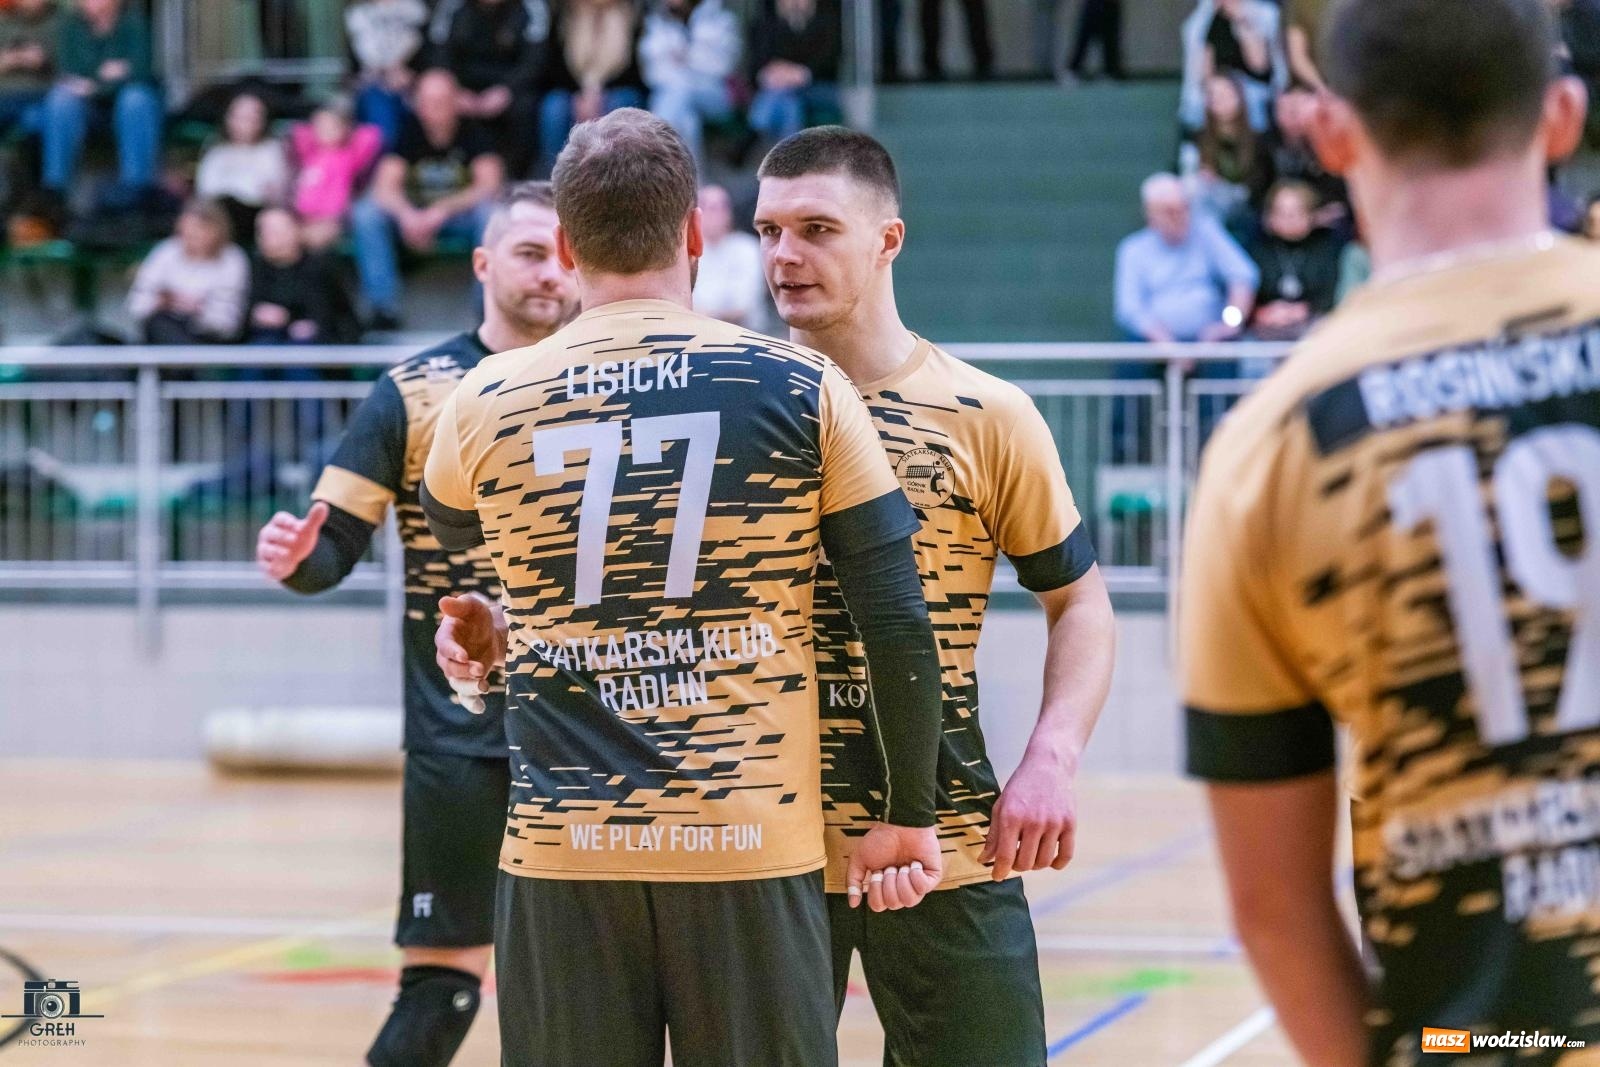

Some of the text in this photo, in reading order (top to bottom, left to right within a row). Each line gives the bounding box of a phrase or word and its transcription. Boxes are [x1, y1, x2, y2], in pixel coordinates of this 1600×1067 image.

[566, 353, 689, 401] LISICKI
[532, 410, 721, 607] 77
[702, 622, 778, 663] KLUB
[598, 670, 709, 712] RADLIN
[829, 683, 866, 709] KO
[569, 823, 762, 851] WE PLAY FOR FUN
